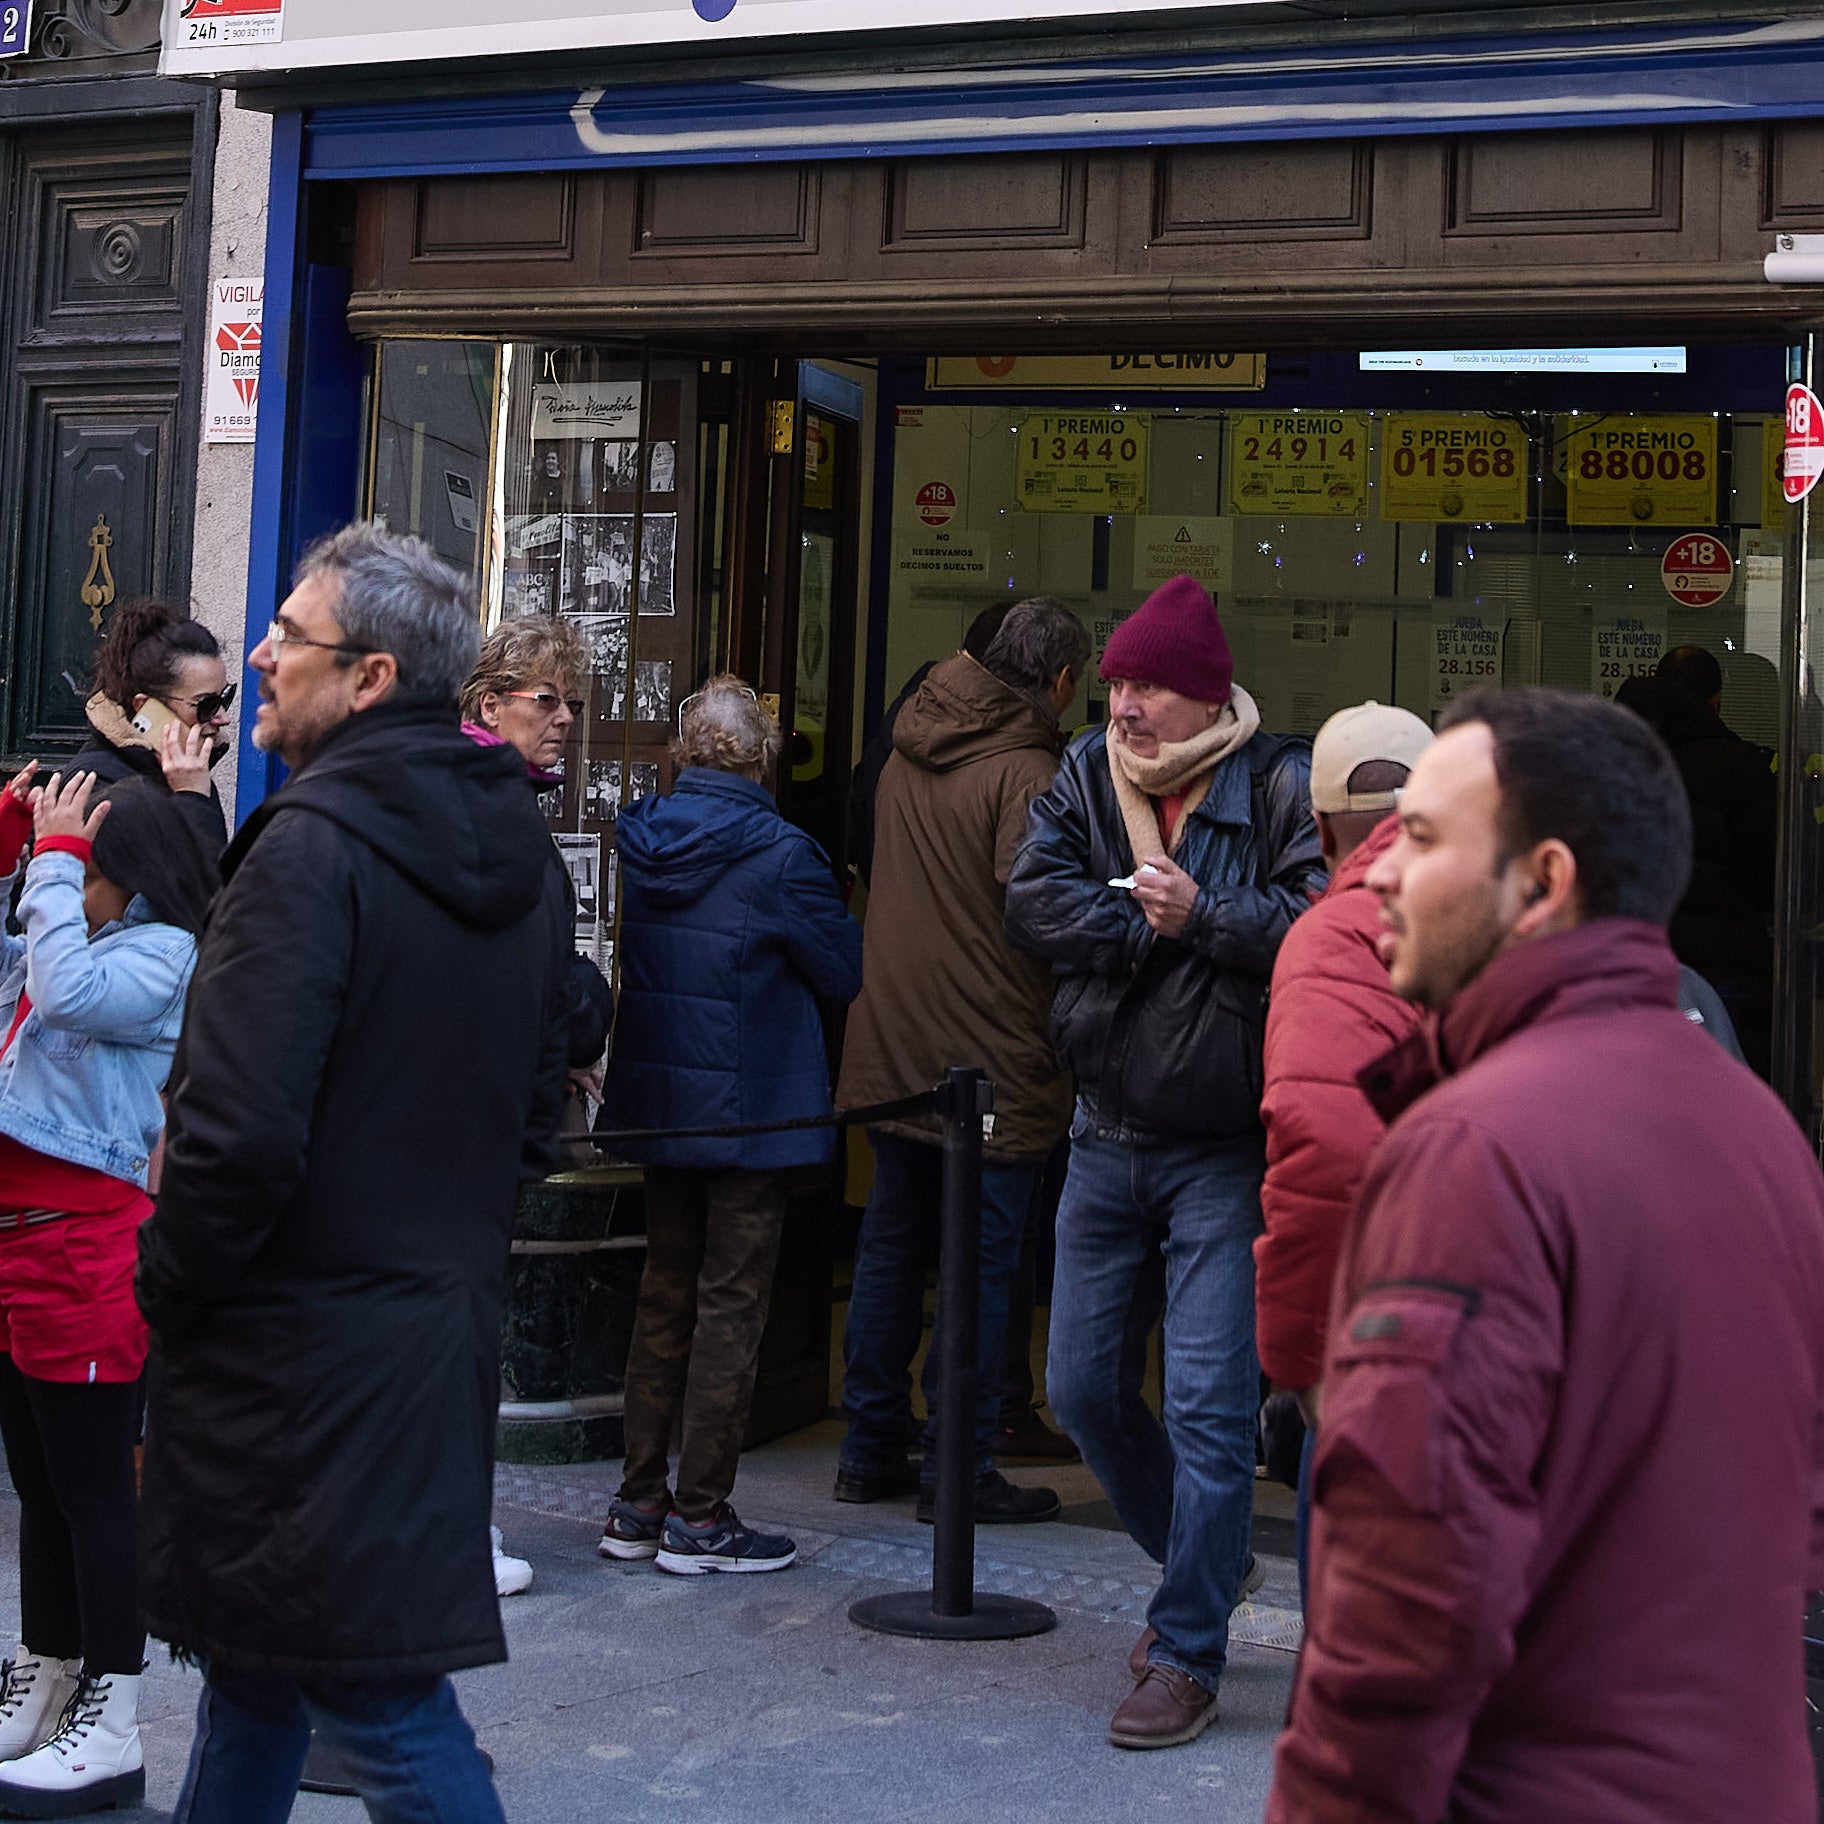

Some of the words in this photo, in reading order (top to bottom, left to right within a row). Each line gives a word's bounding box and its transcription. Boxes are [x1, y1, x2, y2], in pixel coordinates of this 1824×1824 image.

[189, 22, 217, 40] 24h
[232, 30, 246, 38] 900
[247, 29, 259, 37] 321
[262, 28, 275, 36] 111
[219, 285, 264, 303] VIGILA
[247, 307, 261, 318] por
[220, 352, 261, 368] Diam
[214, 416, 227, 425] 91
[229, 415, 251, 425] 669
[1057, 418, 1125, 435] PREMIO
[1273, 418, 1343, 435] PREMIO
[1422, 430, 1507, 448] PREMIO
[1607, 432, 1694, 449] PREMIO
[1031, 437, 1137, 461] 13440
[1244, 437, 1356, 461] 24914
[1394, 447, 1515, 477] 01568
[1580, 450, 1706, 481] 88008
[924, 486, 947, 500] +18
[912, 548, 973, 557] RESERVAMOS
[1677, 542, 1716, 565] +18
[900, 562, 941, 571] DECIMOS
[943, 562, 984, 571] SUELTOS
[1437, 630, 1458, 642] ESTE
[1598, 633, 1619, 645] ESTE
[1438, 643, 1450, 654] DE
[1455, 643, 1467, 655] LA
[1473, 644, 1497, 656] CASA
[1599, 646, 1611, 658] DE
[1617, 646, 1628, 658] LA
[1634, 647, 1660, 659] CASA
[1439, 659, 1495, 675] 28.156
[1600, 662, 1658, 678] 28.156
